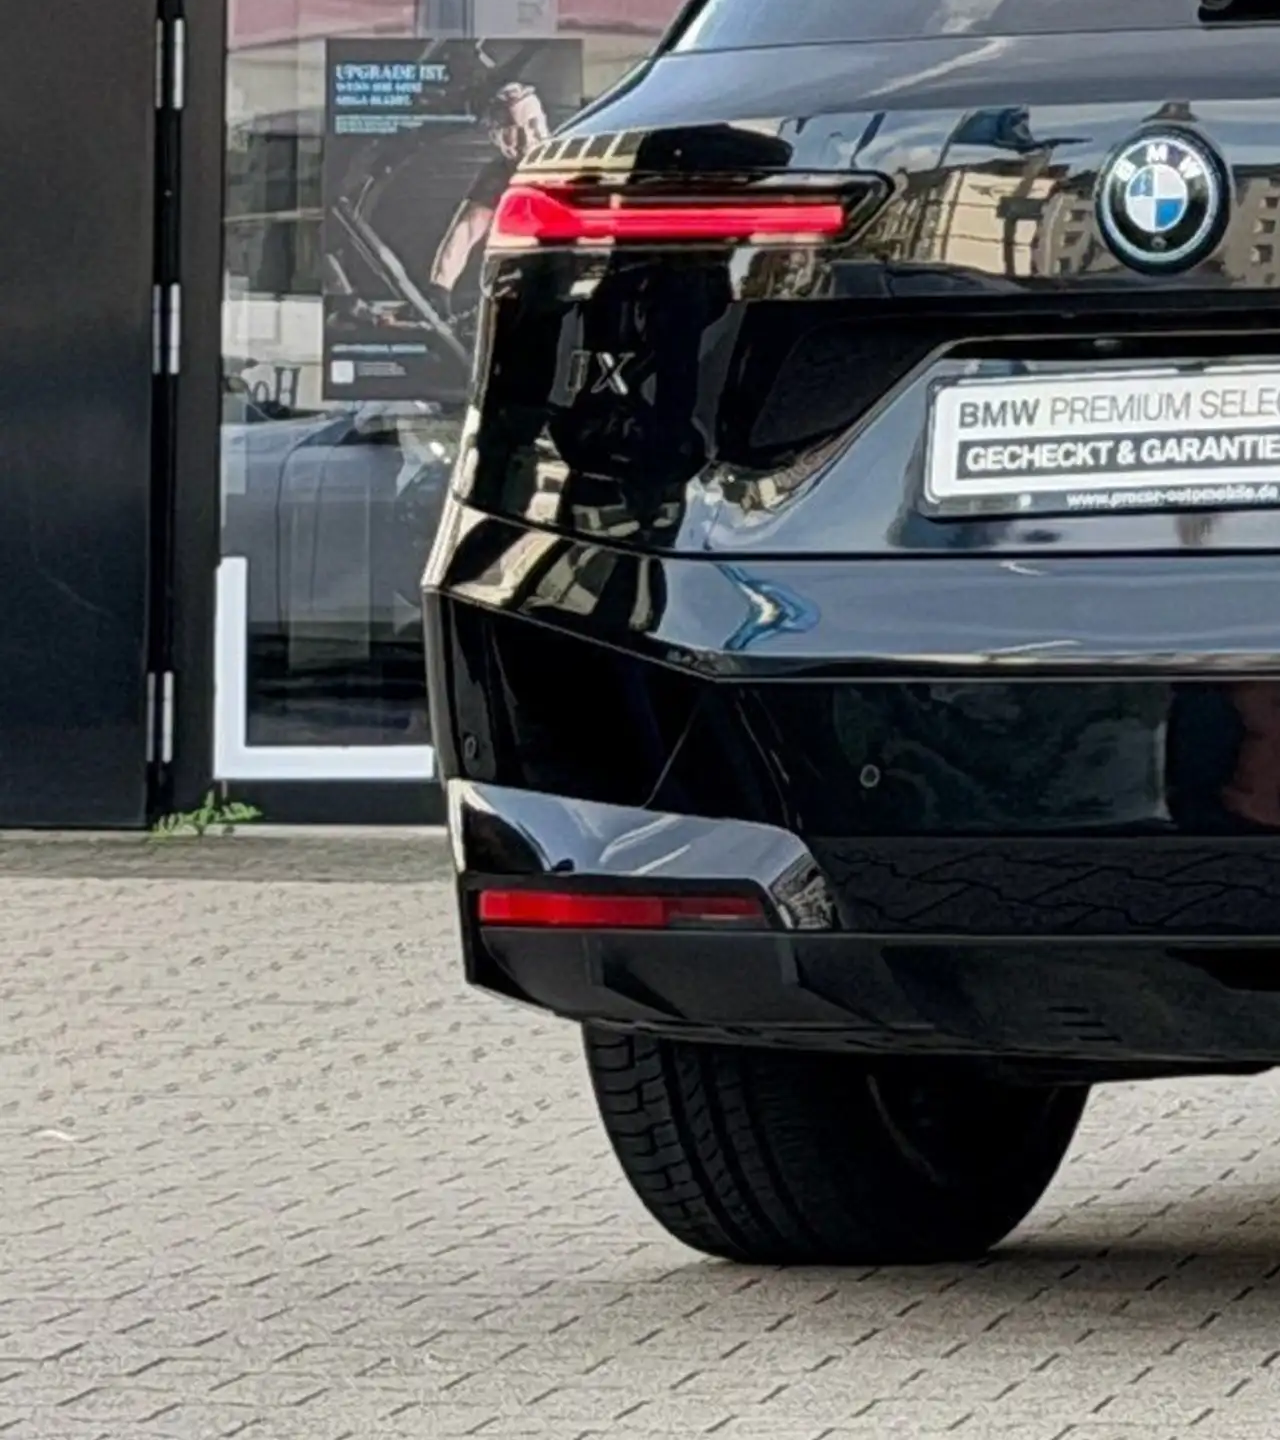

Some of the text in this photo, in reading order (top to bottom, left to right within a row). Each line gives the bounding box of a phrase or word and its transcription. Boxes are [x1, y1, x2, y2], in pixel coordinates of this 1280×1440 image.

[335, 63, 417, 81] UPGRADE
[958, 397, 1041, 429] BMW
[1050, 391, 1192, 426] PREMIUM
[965, 440, 1114, 473] GECHECKT
[1116, 439, 1136, 466] &
